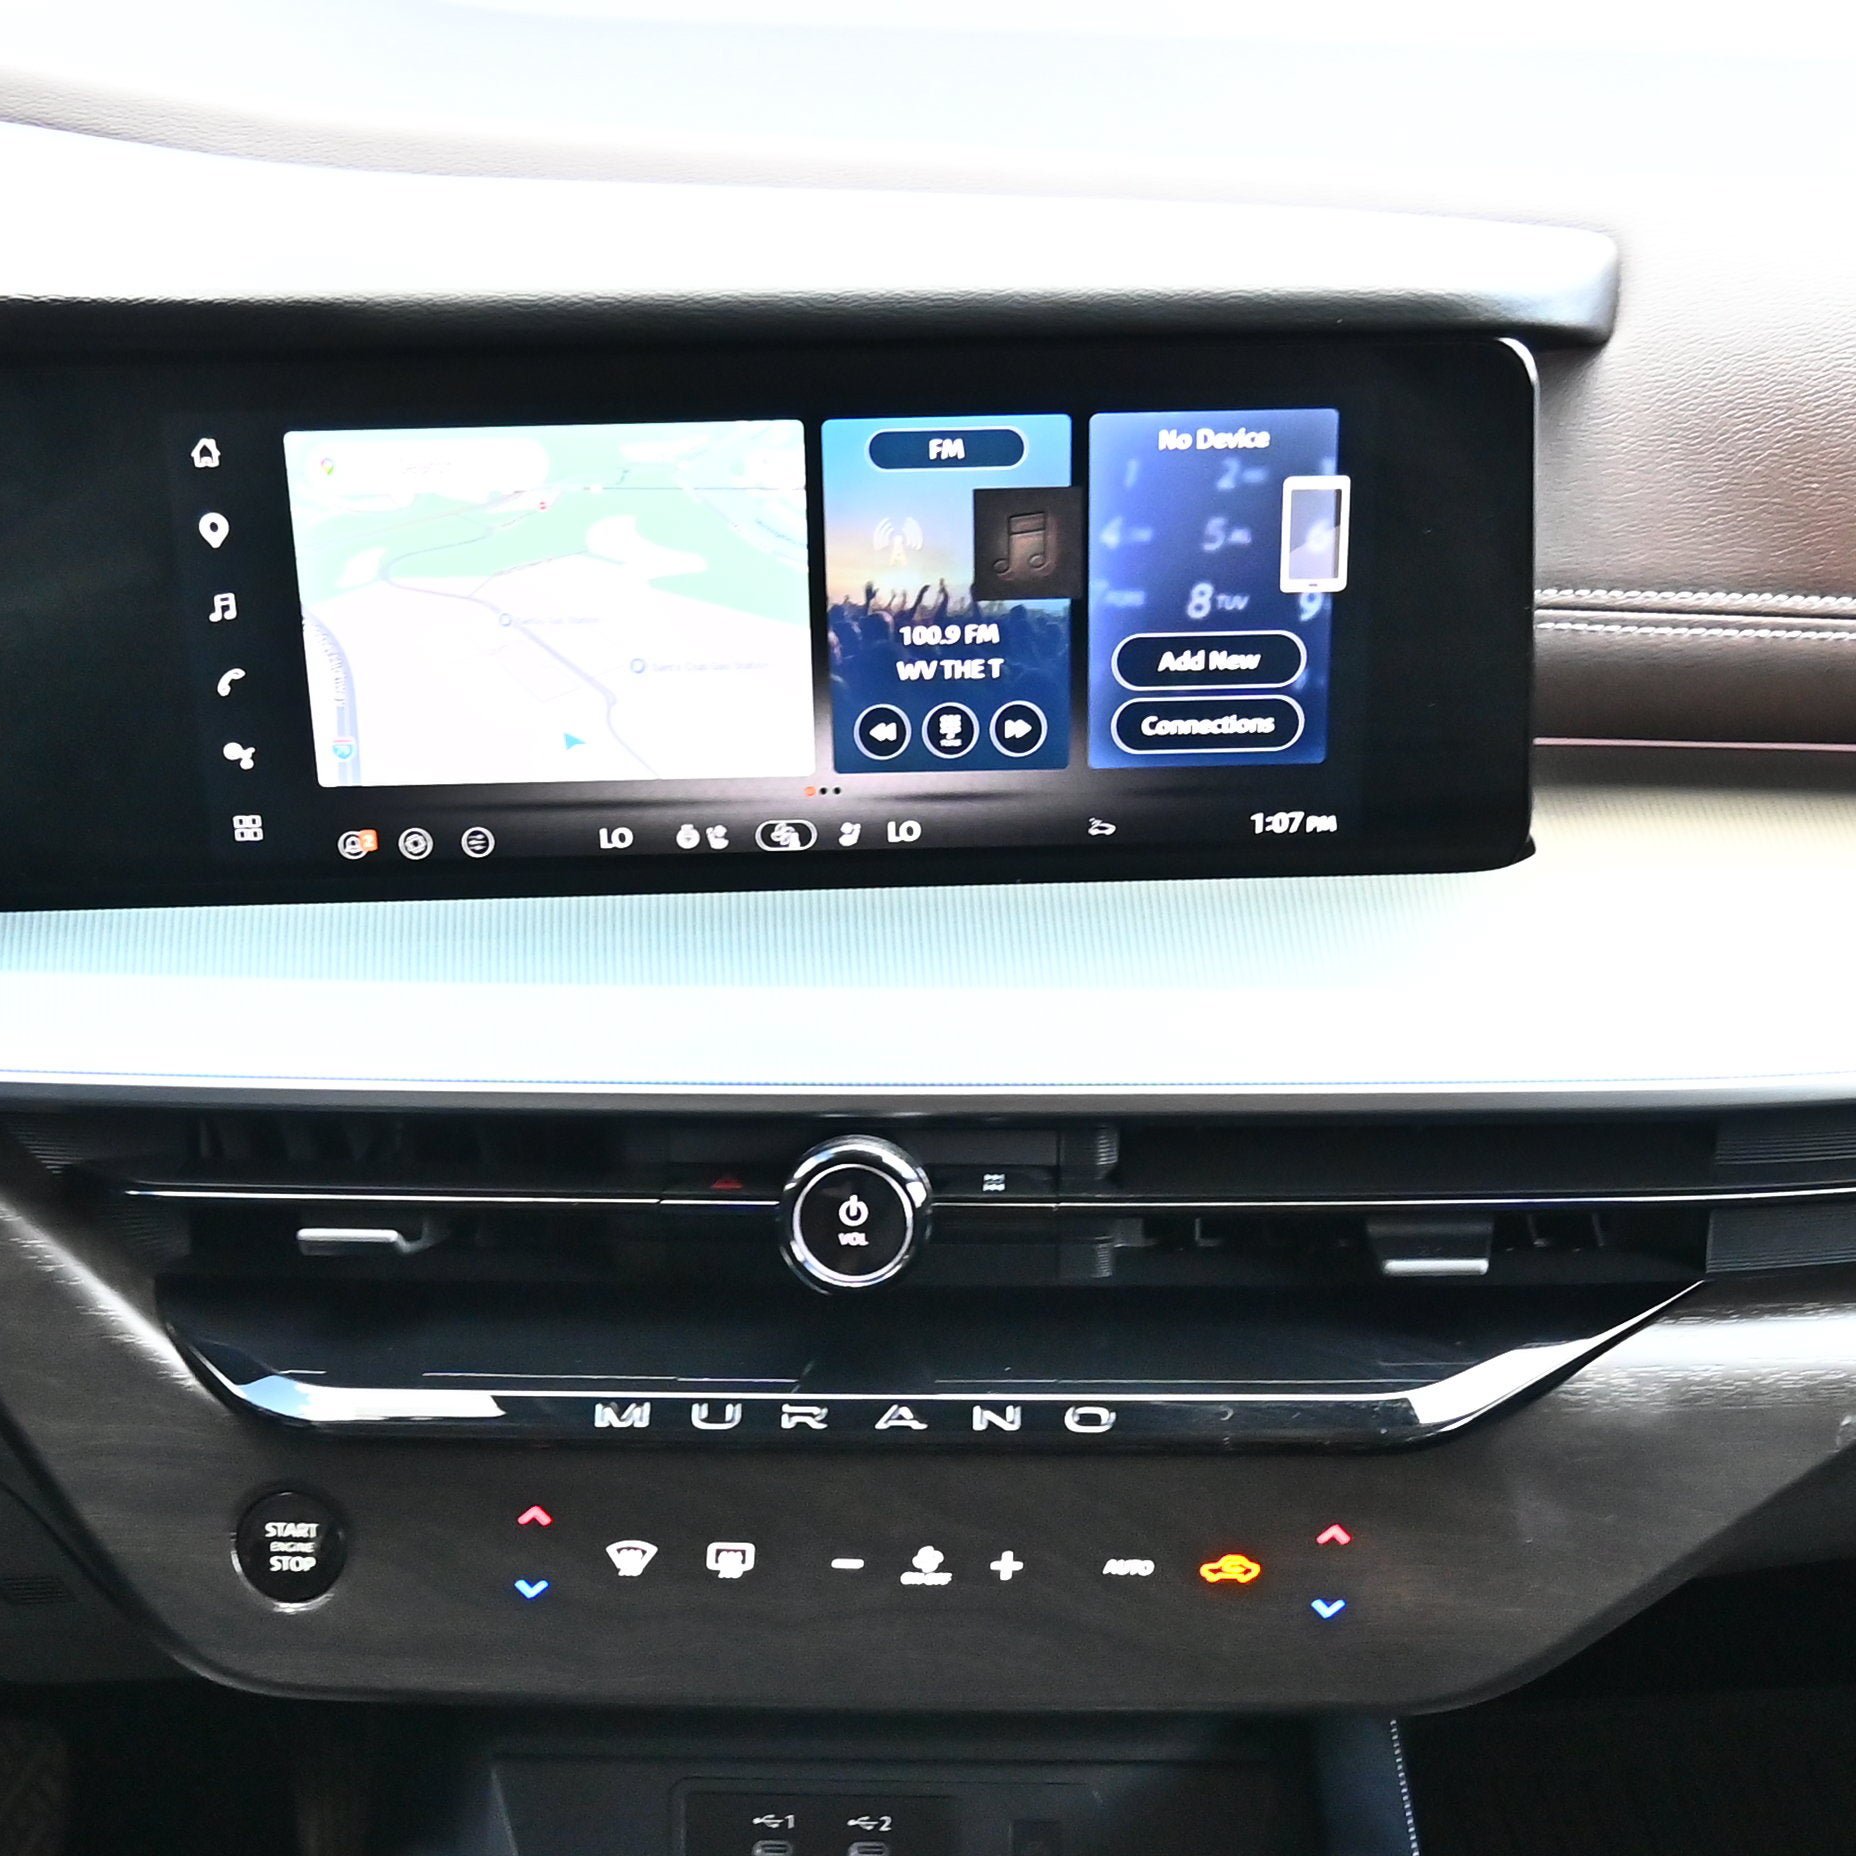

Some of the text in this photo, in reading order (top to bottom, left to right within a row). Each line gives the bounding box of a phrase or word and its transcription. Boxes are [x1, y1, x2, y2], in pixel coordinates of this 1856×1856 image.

[929, 439, 965, 460] FM
[1158, 428, 1270, 450] No Device
[1187, 581, 1215, 619] 8
[899, 623, 1000, 645] 100.9 FM
[896, 658, 1004, 681] WV THE T
[1157, 650, 1261, 672] Add New
[1141, 715, 1275, 736] Connections
[887, 820, 922, 843] LO
[1250, 811, 1337, 834] 1:07 PM
[599, 827, 634, 849] LO
[838, 1233, 869, 1246] VOL
[594, 1402, 1117, 1434] MURANO
[265, 1522, 319, 1538] START
[270, 1556, 316, 1572] STOP
[785, 1814, 795, 1830] 1
[879, 1816, 893, 1831] 2
